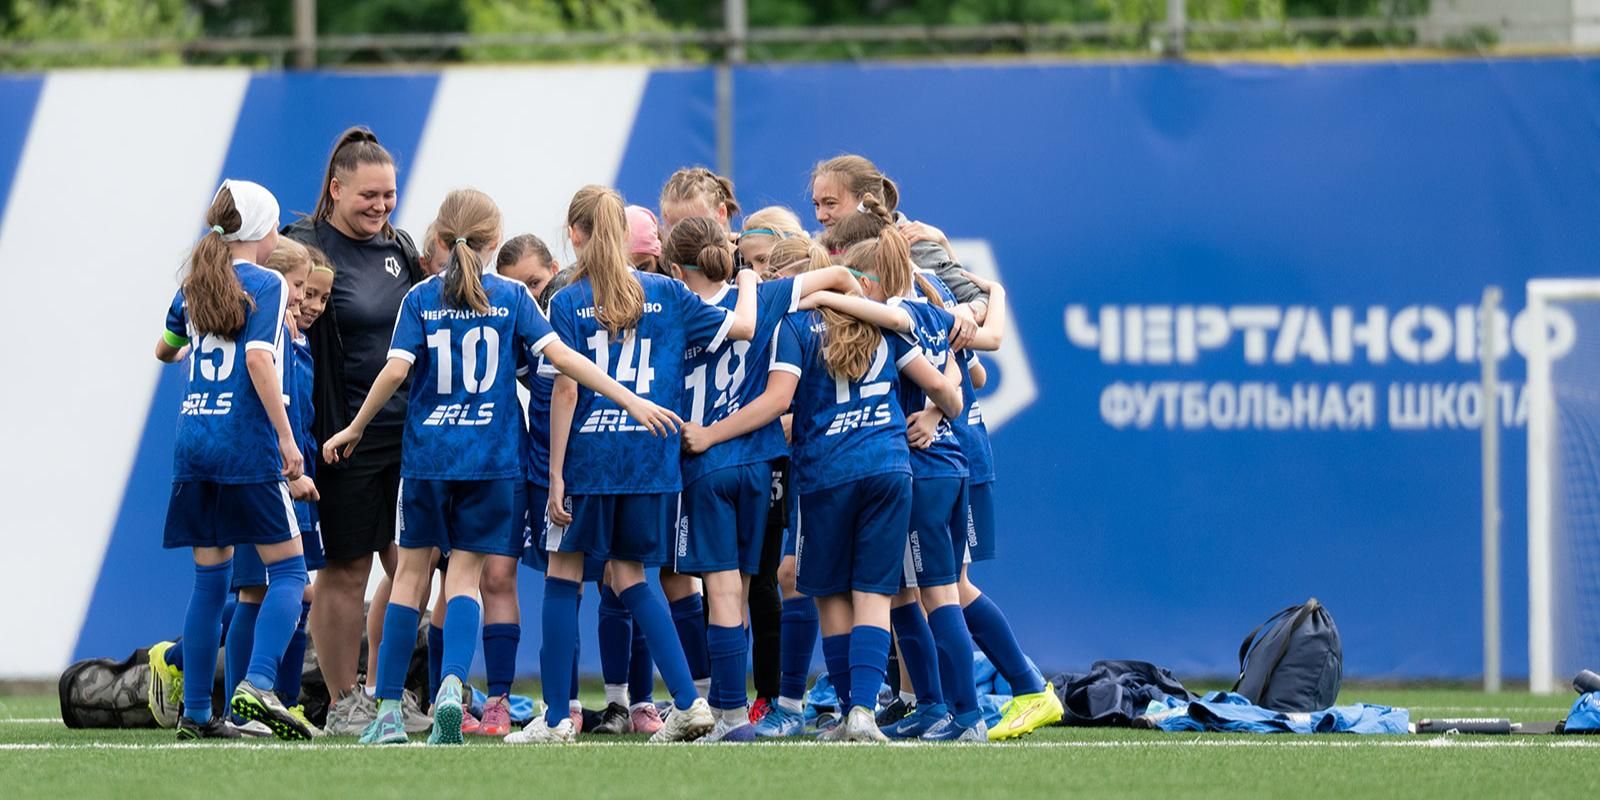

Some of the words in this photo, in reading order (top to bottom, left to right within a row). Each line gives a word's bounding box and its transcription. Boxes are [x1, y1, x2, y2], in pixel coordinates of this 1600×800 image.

[1065, 305, 1577, 363] ЧЕРТАНОВО
[426, 326, 500, 394] 10
[587, 328, 655, 396] 14
[438, 403, 494, 425] RLS
[596, 409, 648, 432] RL
[840, 403, 891, 433] RLS
[1100, 381, 1374, 430] ФУТБОЛЬНАЯ
